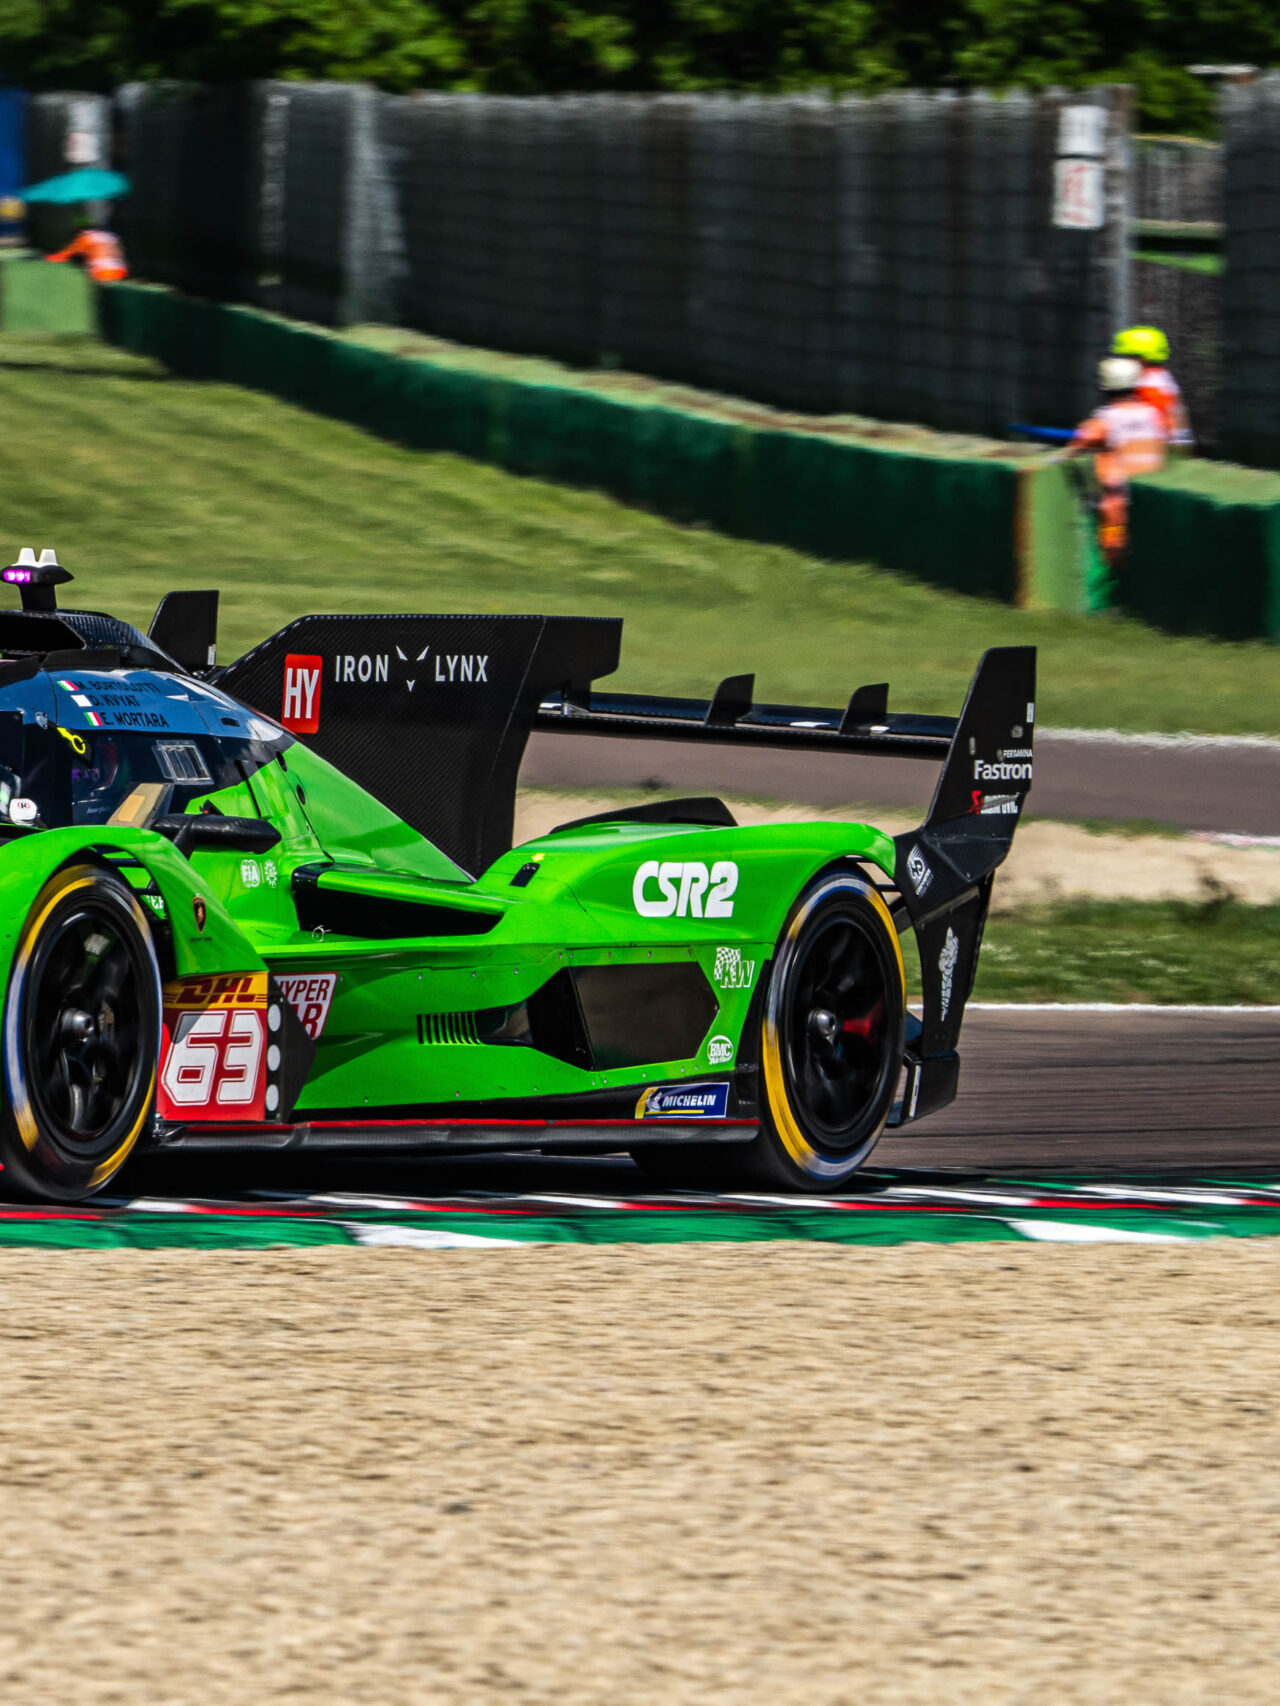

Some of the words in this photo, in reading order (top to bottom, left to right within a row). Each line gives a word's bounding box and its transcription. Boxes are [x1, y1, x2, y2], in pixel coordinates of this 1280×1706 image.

[335, 654, 389, 682] IRON
[435, 655, 489, 682] LYNX
[102, 695, 140, 707] KVYAT
[284, 667, 320, 719] HY
[100, 711, 114, 726] E.
[113, 712, 170, 728] MORTARA
[974, 760, 1032, 780] Fastron
[633, 861, 738, 918] CSR2
[720, 960, 755, 988] KW
[176, 977, 256, 1004] DHL
[280, 979, 330, 1002] YPER
[161, 1010, 263, 1107] 63
[710, 1043, 731, 1057] BMC
[662, 1094, 717, 1107] MICHELIN
